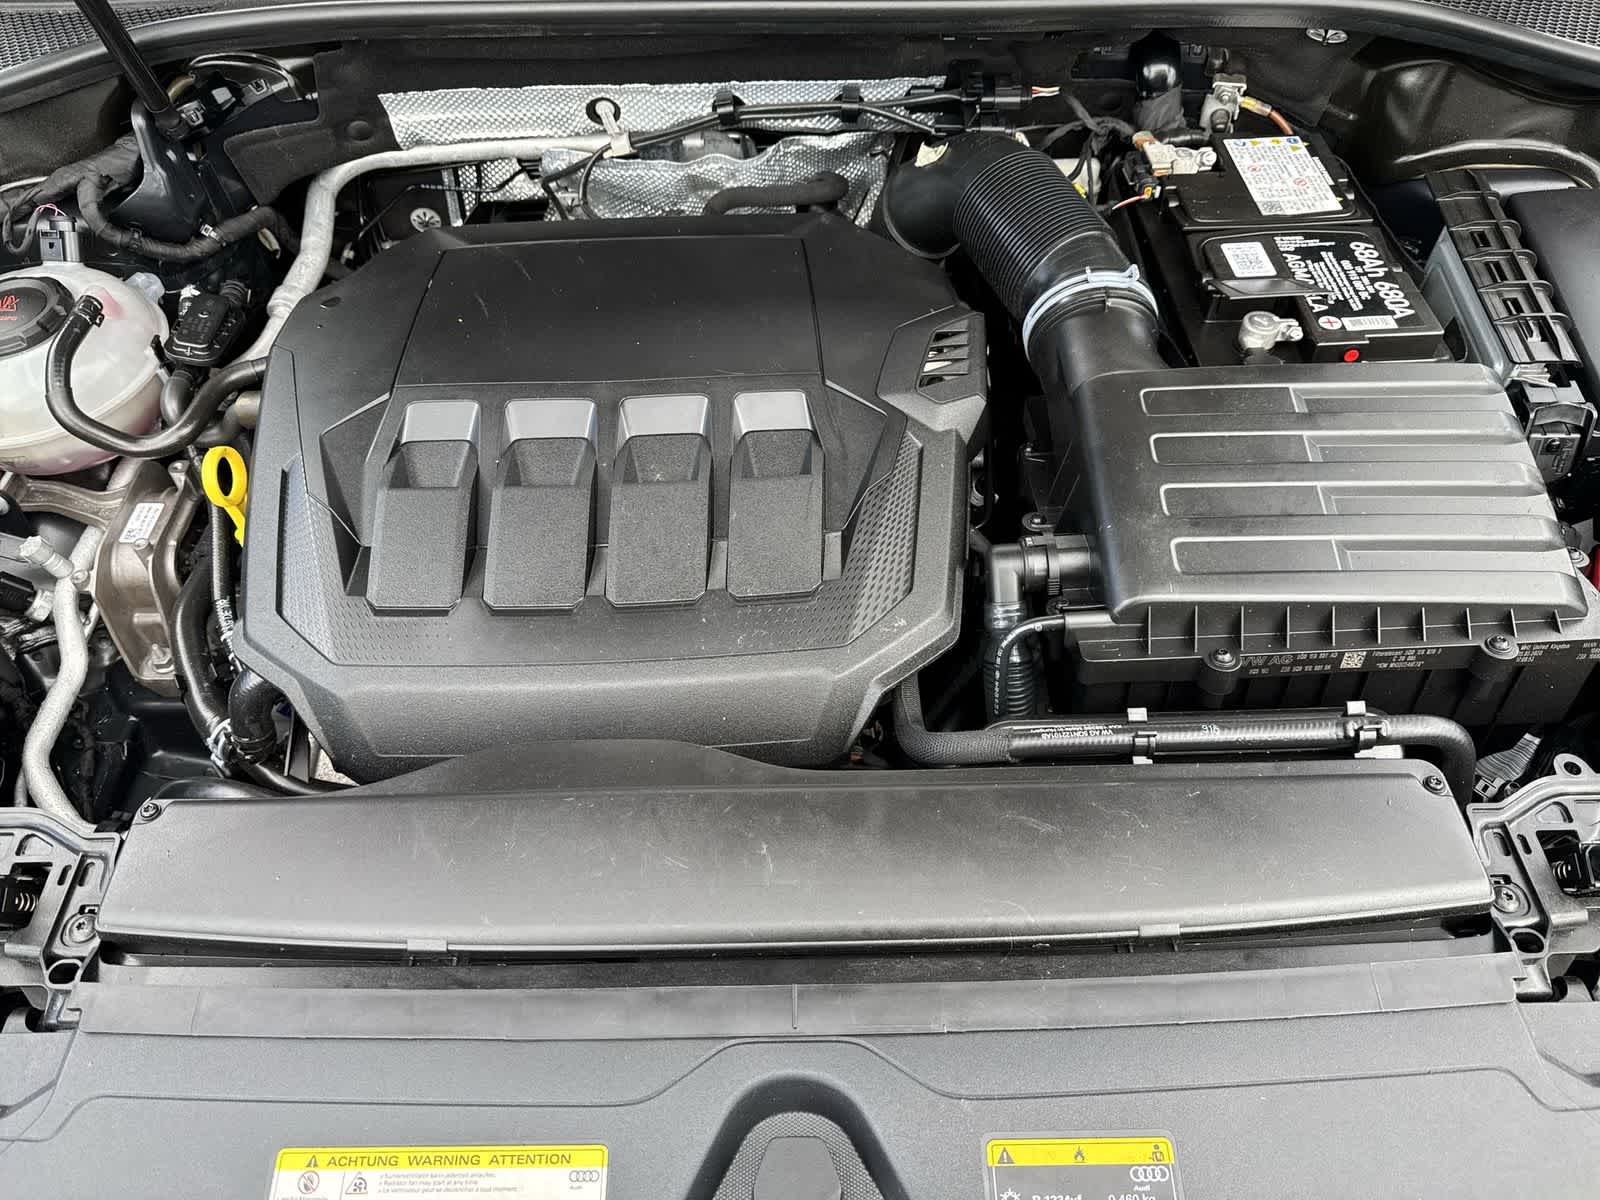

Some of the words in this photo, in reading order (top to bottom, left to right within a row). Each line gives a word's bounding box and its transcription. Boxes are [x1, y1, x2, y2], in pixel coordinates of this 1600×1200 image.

[1349, 241, 1388, 277] 68Ah
[1373, 281, 1415, 319] 680A
[1268, 654, 1294, 666] AG
[1089, 729, 1100, 737] AG
[1101, 728, 1114, 736] VW
[327, 1155, 399, 1167] ACHTUNG
[407, 1154, 481, 1166] WARNING
[488, 1153, 572, 1166] ATTENTION
